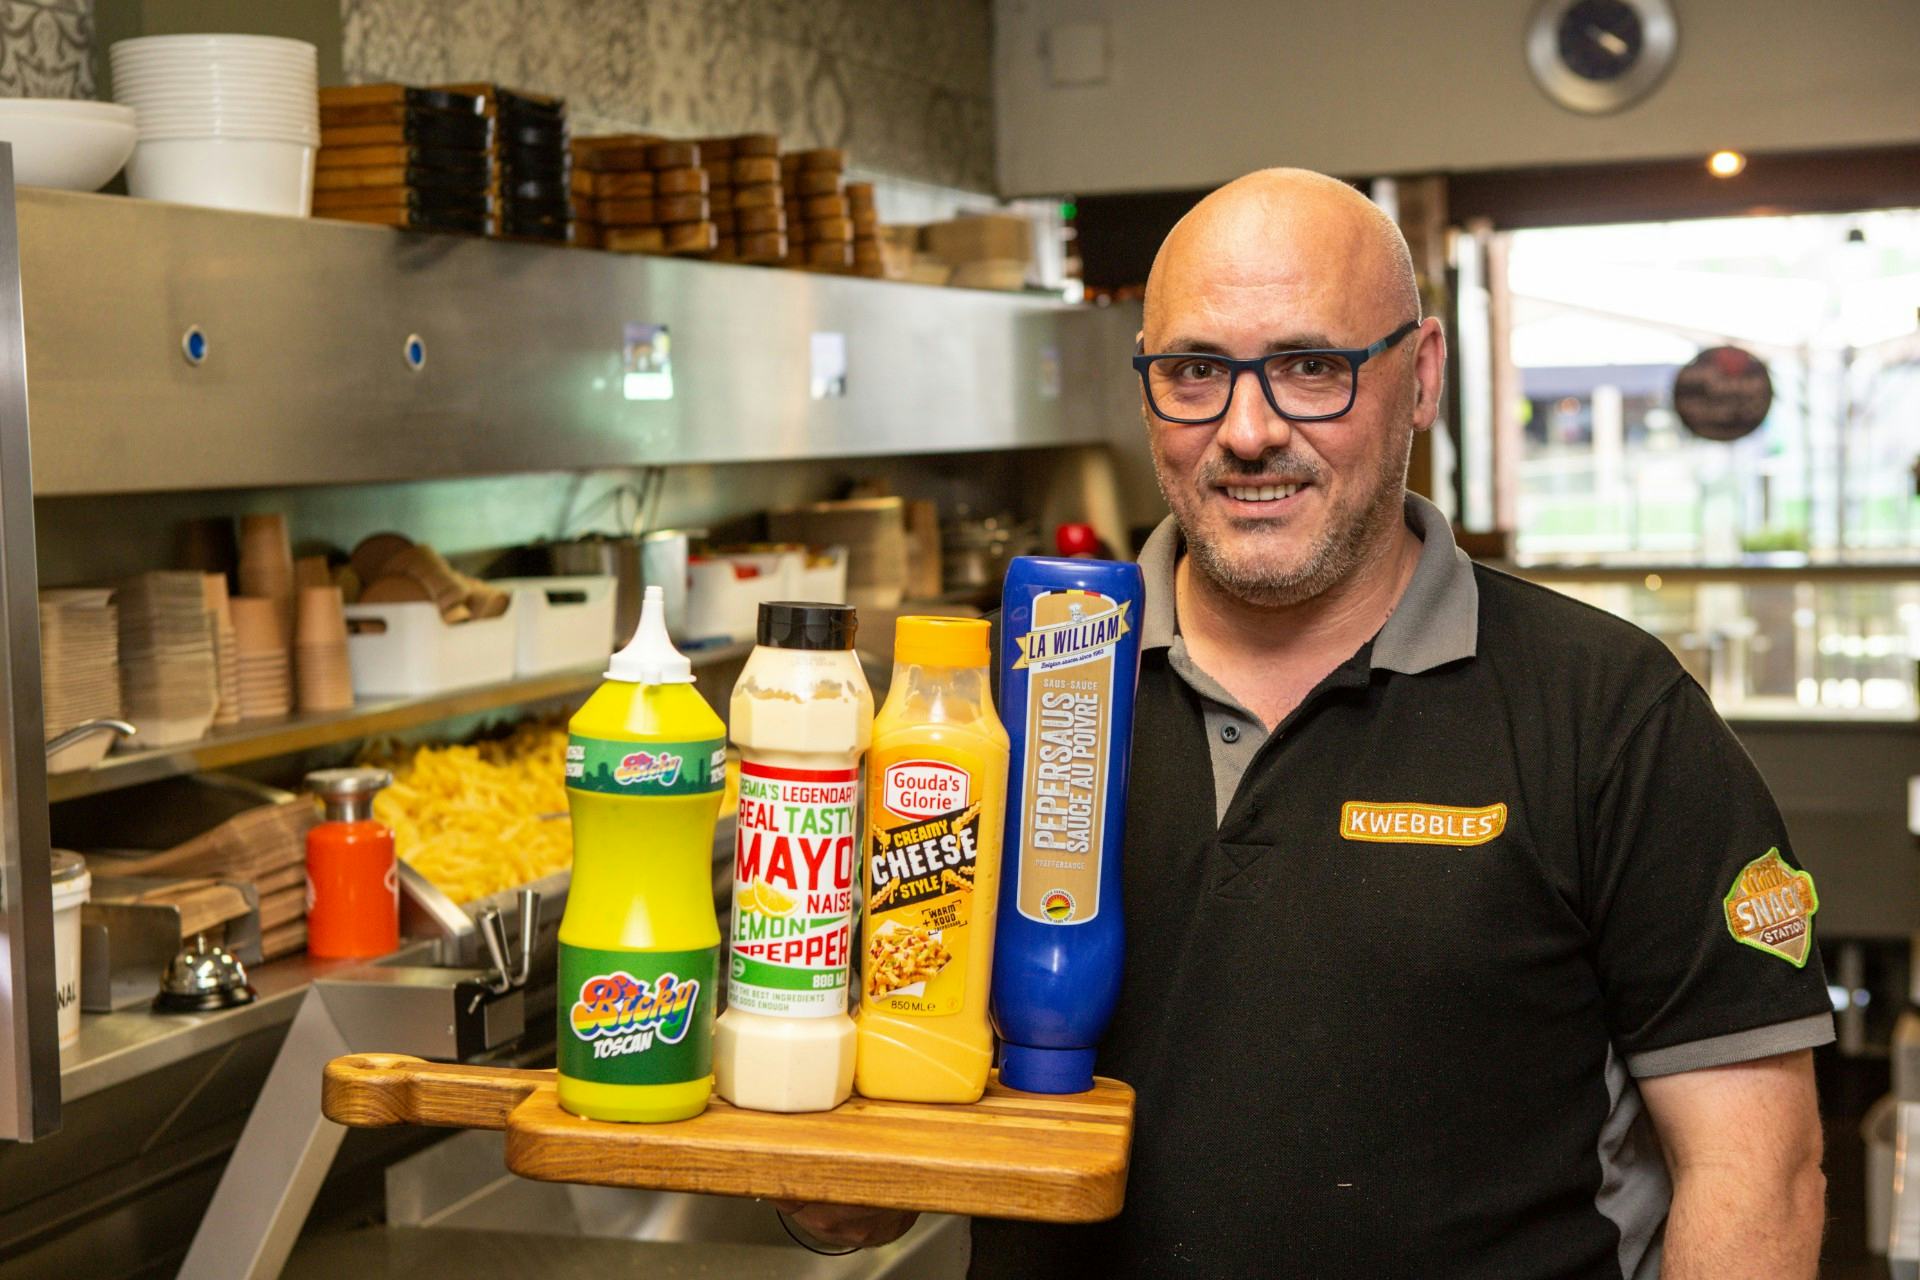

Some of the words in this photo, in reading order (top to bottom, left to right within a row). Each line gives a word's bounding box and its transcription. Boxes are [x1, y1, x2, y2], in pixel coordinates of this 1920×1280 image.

[1029, 633, 1046, 660] LA
[1054, 614, 1120, 655] WILLIAM
[1072, 692, 1098, 759] POIVRE
[893, 771, 960, 792] Gouda's
[1034, 691, 1075, 850] PEPERSAUS
[1070, 763, 1094, 790] AU
[900, 791, 952, 810] Glorie
[739, 798, 779, 832] REAL
[784, 805, 855, 835] TASTY
[1066, 792, 1092, 853] SAUCE
[893, 819, 948, 848] CREAMY
[736, 827, 854, 891] MAYO
[872, 827, 977, 886] CHEESE
[899, 874, 941, 899] STYLE
[807, 891, 851, 914] NAISE
[929, 904, 956, 919] WARM
[732, 908, 806, 942] LEMON
[934, 913, 956, 927] KOUD
[1763, 919, 1806, 943] STATION
[750, 924, 849, 967] PEPPER
[891, 1000, 910, 1010] 850
[911, 1002, 926, 1011] ML
[593, 1031, 654, 1060] TOSCAN
